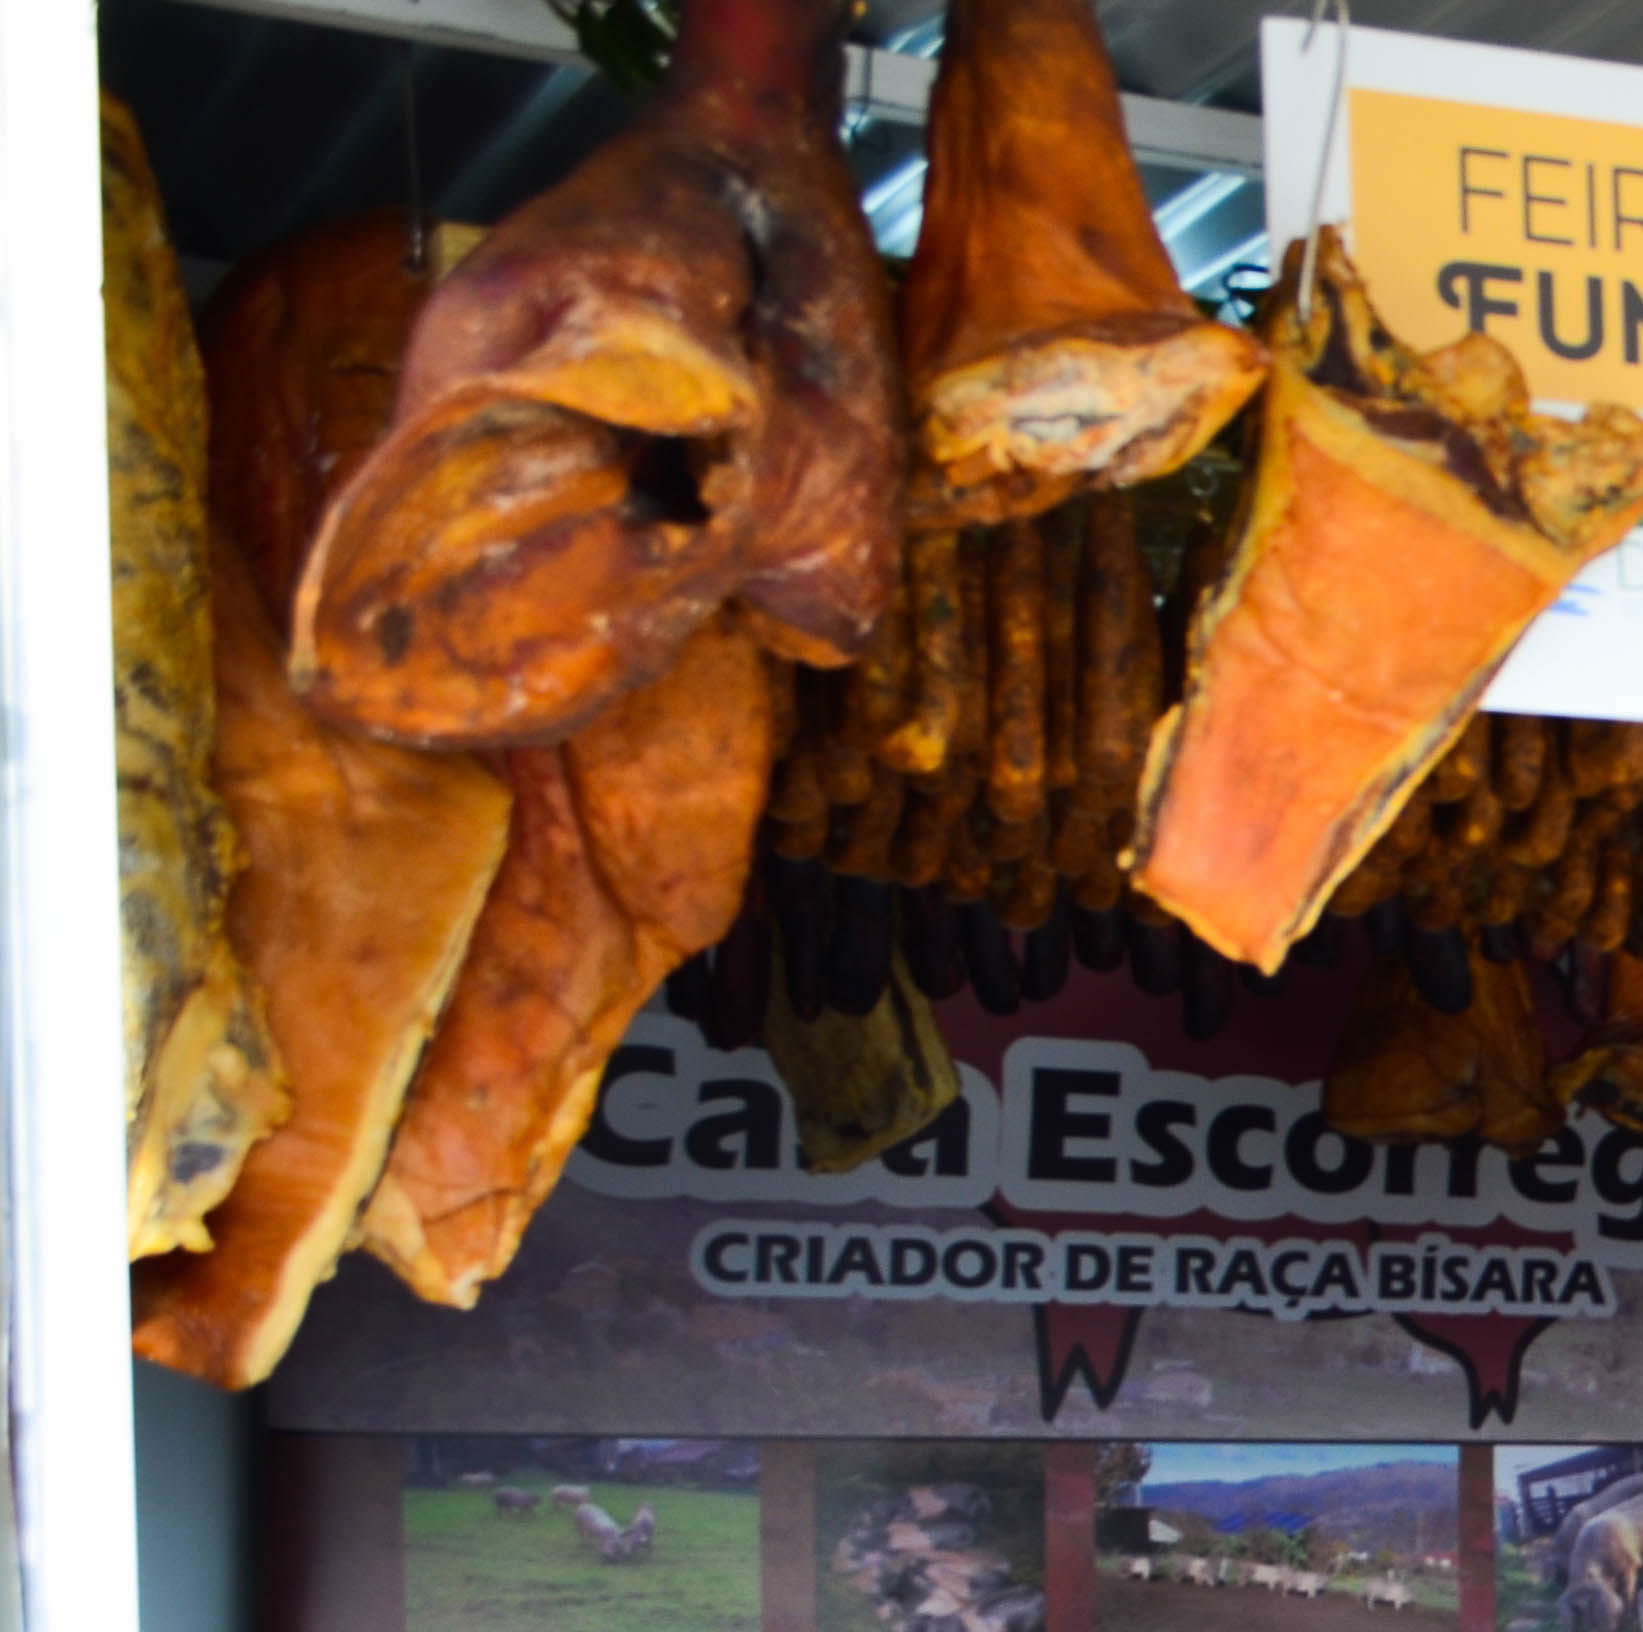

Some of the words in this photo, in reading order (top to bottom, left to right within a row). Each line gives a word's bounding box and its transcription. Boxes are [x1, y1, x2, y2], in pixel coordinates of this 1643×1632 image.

[579, 1044, 971, 1177] Caa
[703, 1231, 1045, 1291] CRIADOR
[1065, 1243, 1155, 1292] DE
[1173, 1246, 1359, 1310] RAÇA
[1377, 1233, 1607, 1304] BÍSARA
